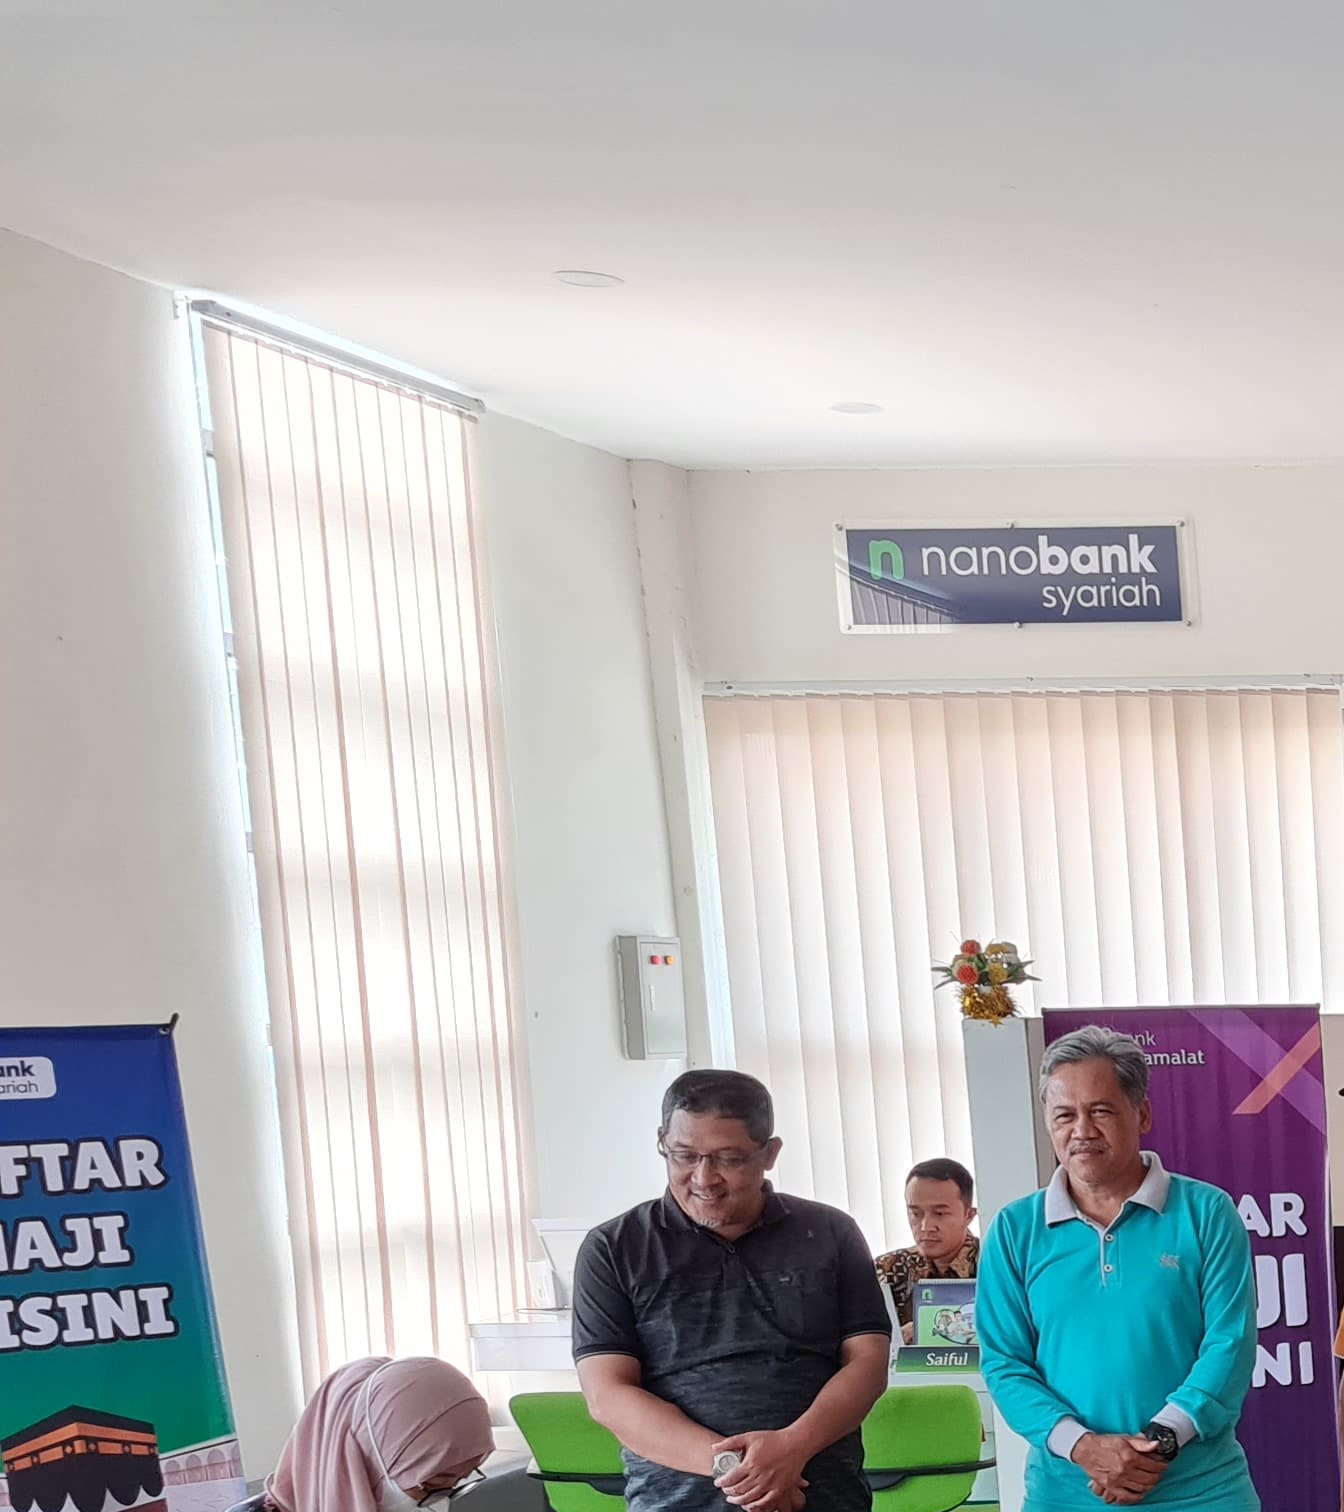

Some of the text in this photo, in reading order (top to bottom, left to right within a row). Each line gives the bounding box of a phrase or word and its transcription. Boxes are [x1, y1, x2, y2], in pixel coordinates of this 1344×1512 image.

[921, 534, 1158, 576] nanobank
[1042, 576, 1161, 616] syariah
[1133, 1030, 1156, 1047] nk
[1144, 1049, 1206, 1066] amalat
[1255, 1253, 1309, 1329] JI
[926, 1352, 968, 1366] Saiful
